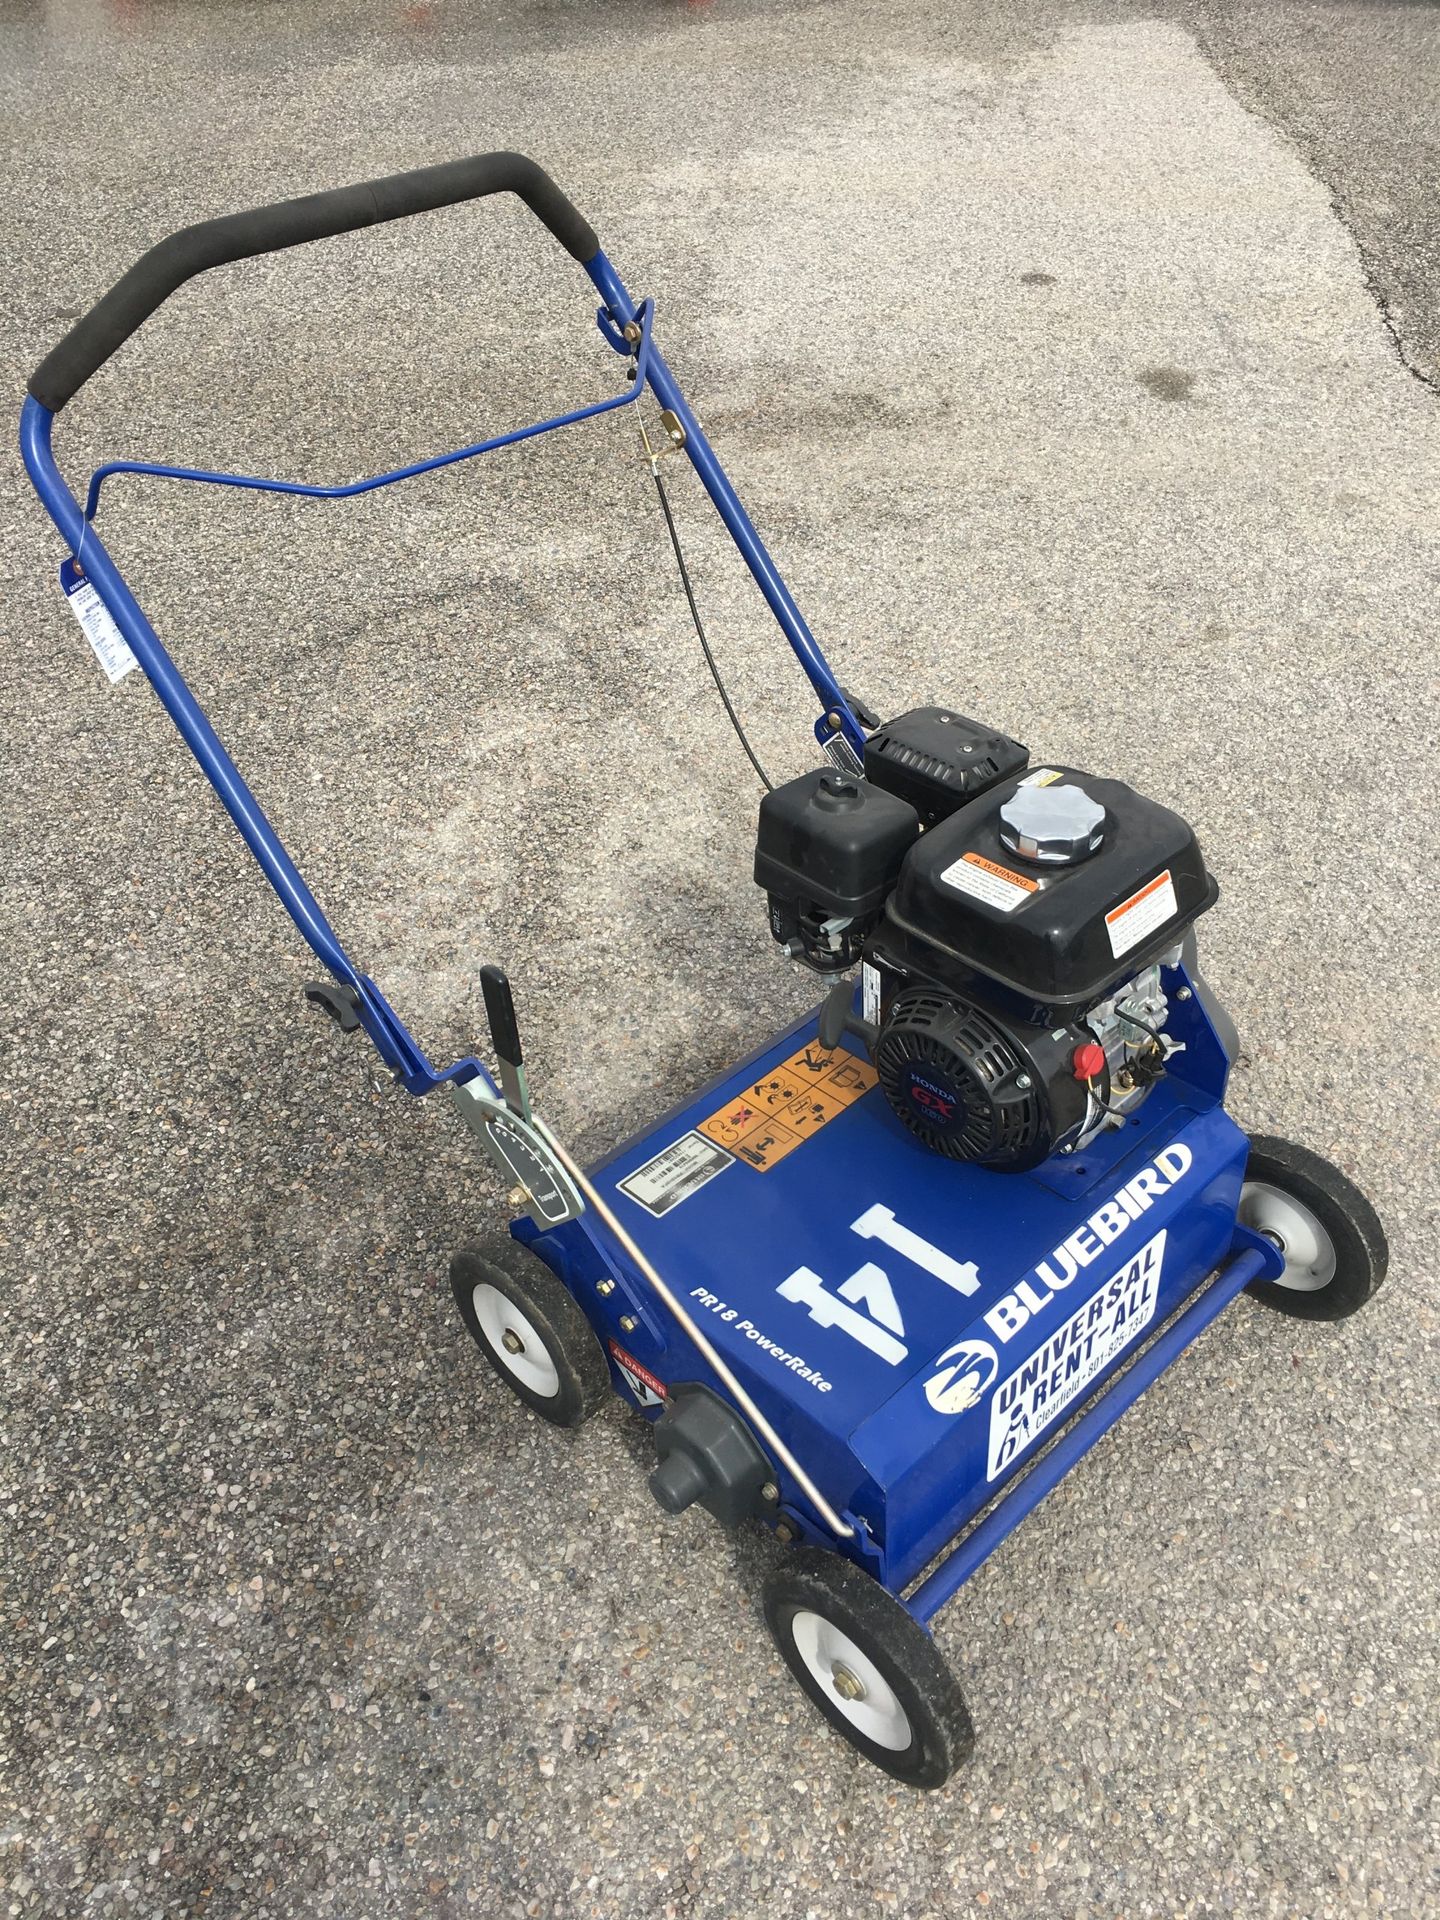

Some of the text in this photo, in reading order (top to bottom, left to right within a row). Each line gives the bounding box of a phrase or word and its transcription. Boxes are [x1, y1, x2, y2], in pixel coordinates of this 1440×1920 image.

[984, 861, 1029, 887] WARNING
[911, 1073, 957, 1104] HONDA
[912, 1086, 954, 1119] GX
[982, 1143, 1193, 1344] BLUEBIRD
[624, 1357, 666, 1397] DANGER
[689, 1287, 832, 1392] PR18 PowerRake
[1000, 1247, 1155, 1414] UNIVERSAL
[1032, 1277, 1151, 1414] RENT-ALL
[1036, 1376, 1080, 1429] Clearfield
[1087, 1306, 1149, 1377] 801-825-7347
